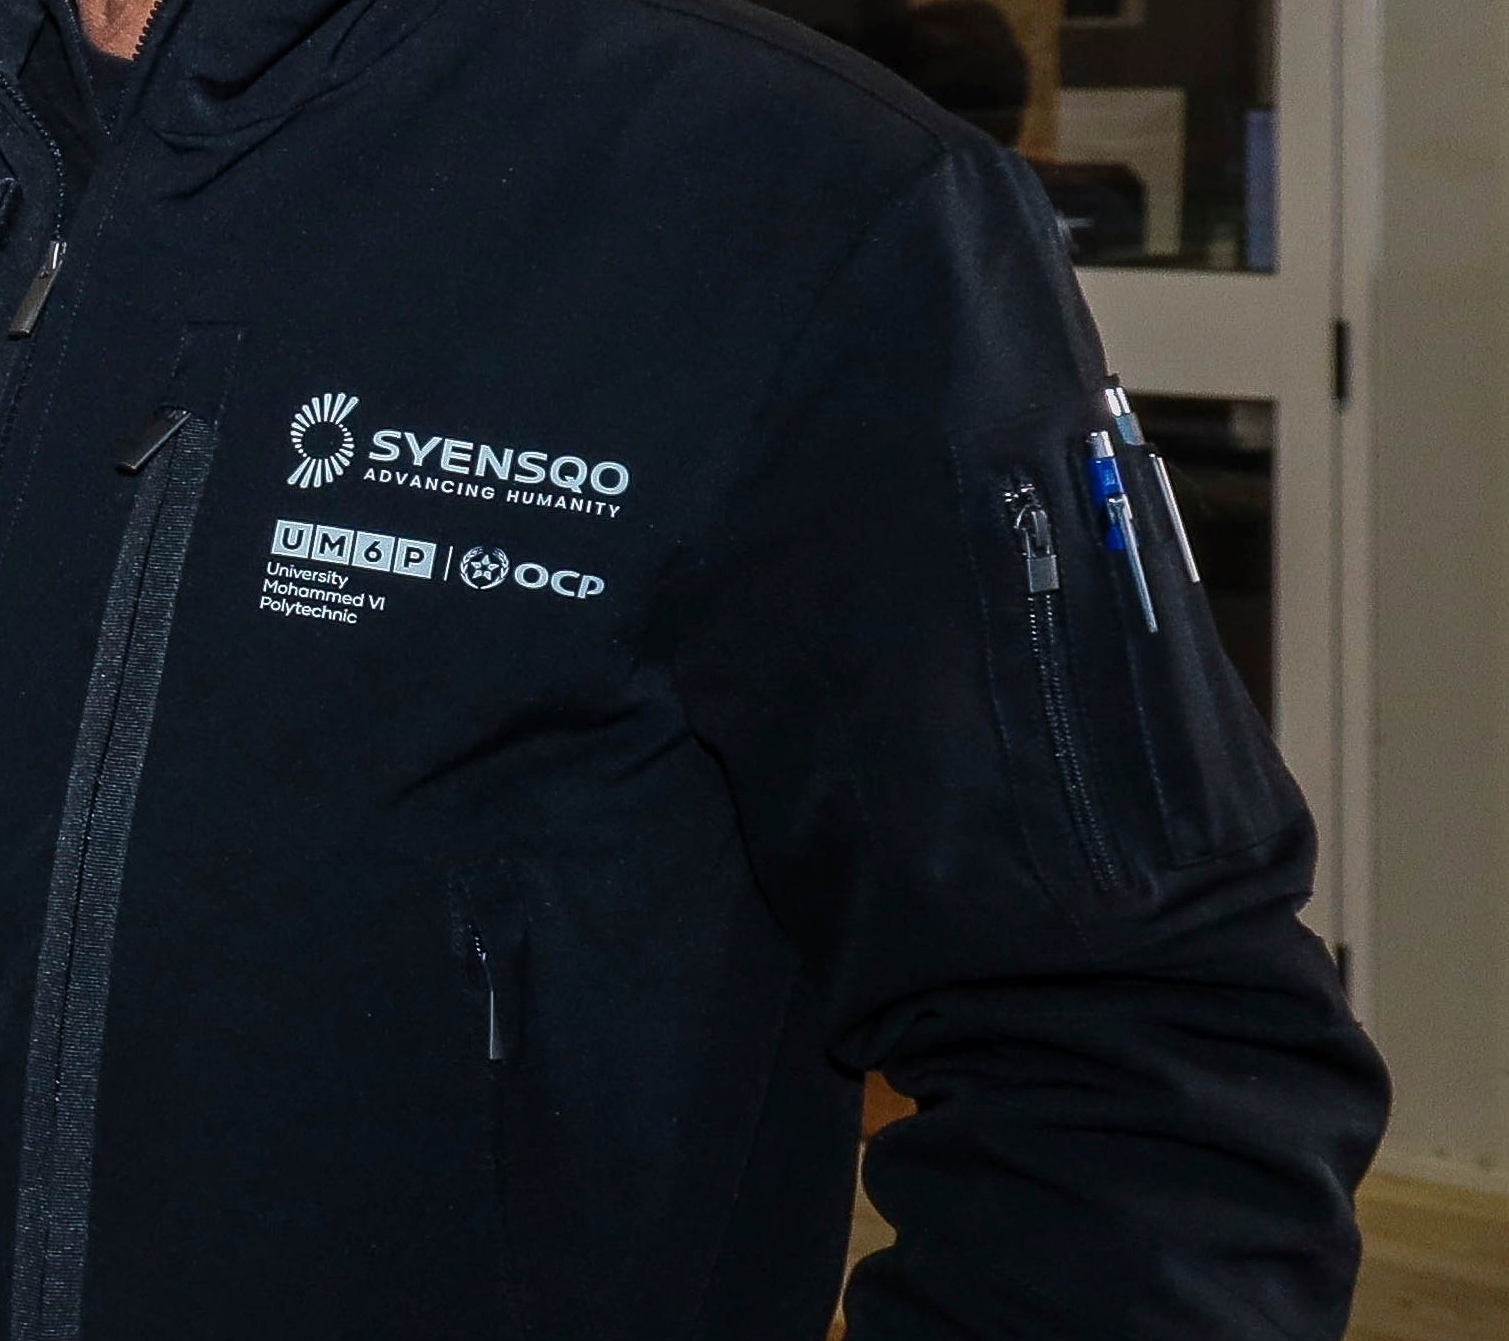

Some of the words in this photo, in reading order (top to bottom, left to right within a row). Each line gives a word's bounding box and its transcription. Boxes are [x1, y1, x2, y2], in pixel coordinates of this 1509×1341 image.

[368, 430, 629, 495] SYENSQO
[363, 468, 495, 500] ADVANCING
[505, 489, 622, 519] HUMANITY
[278, 527, 429, 571] UM6P
[266, 562, 349, 589] University
[514, 562, 605, 599] OCP
[259, 596, 358, 625] Polytechnic
[263, 579, 365, 608] Mohammed
[368, 595, 387, 611] VI
